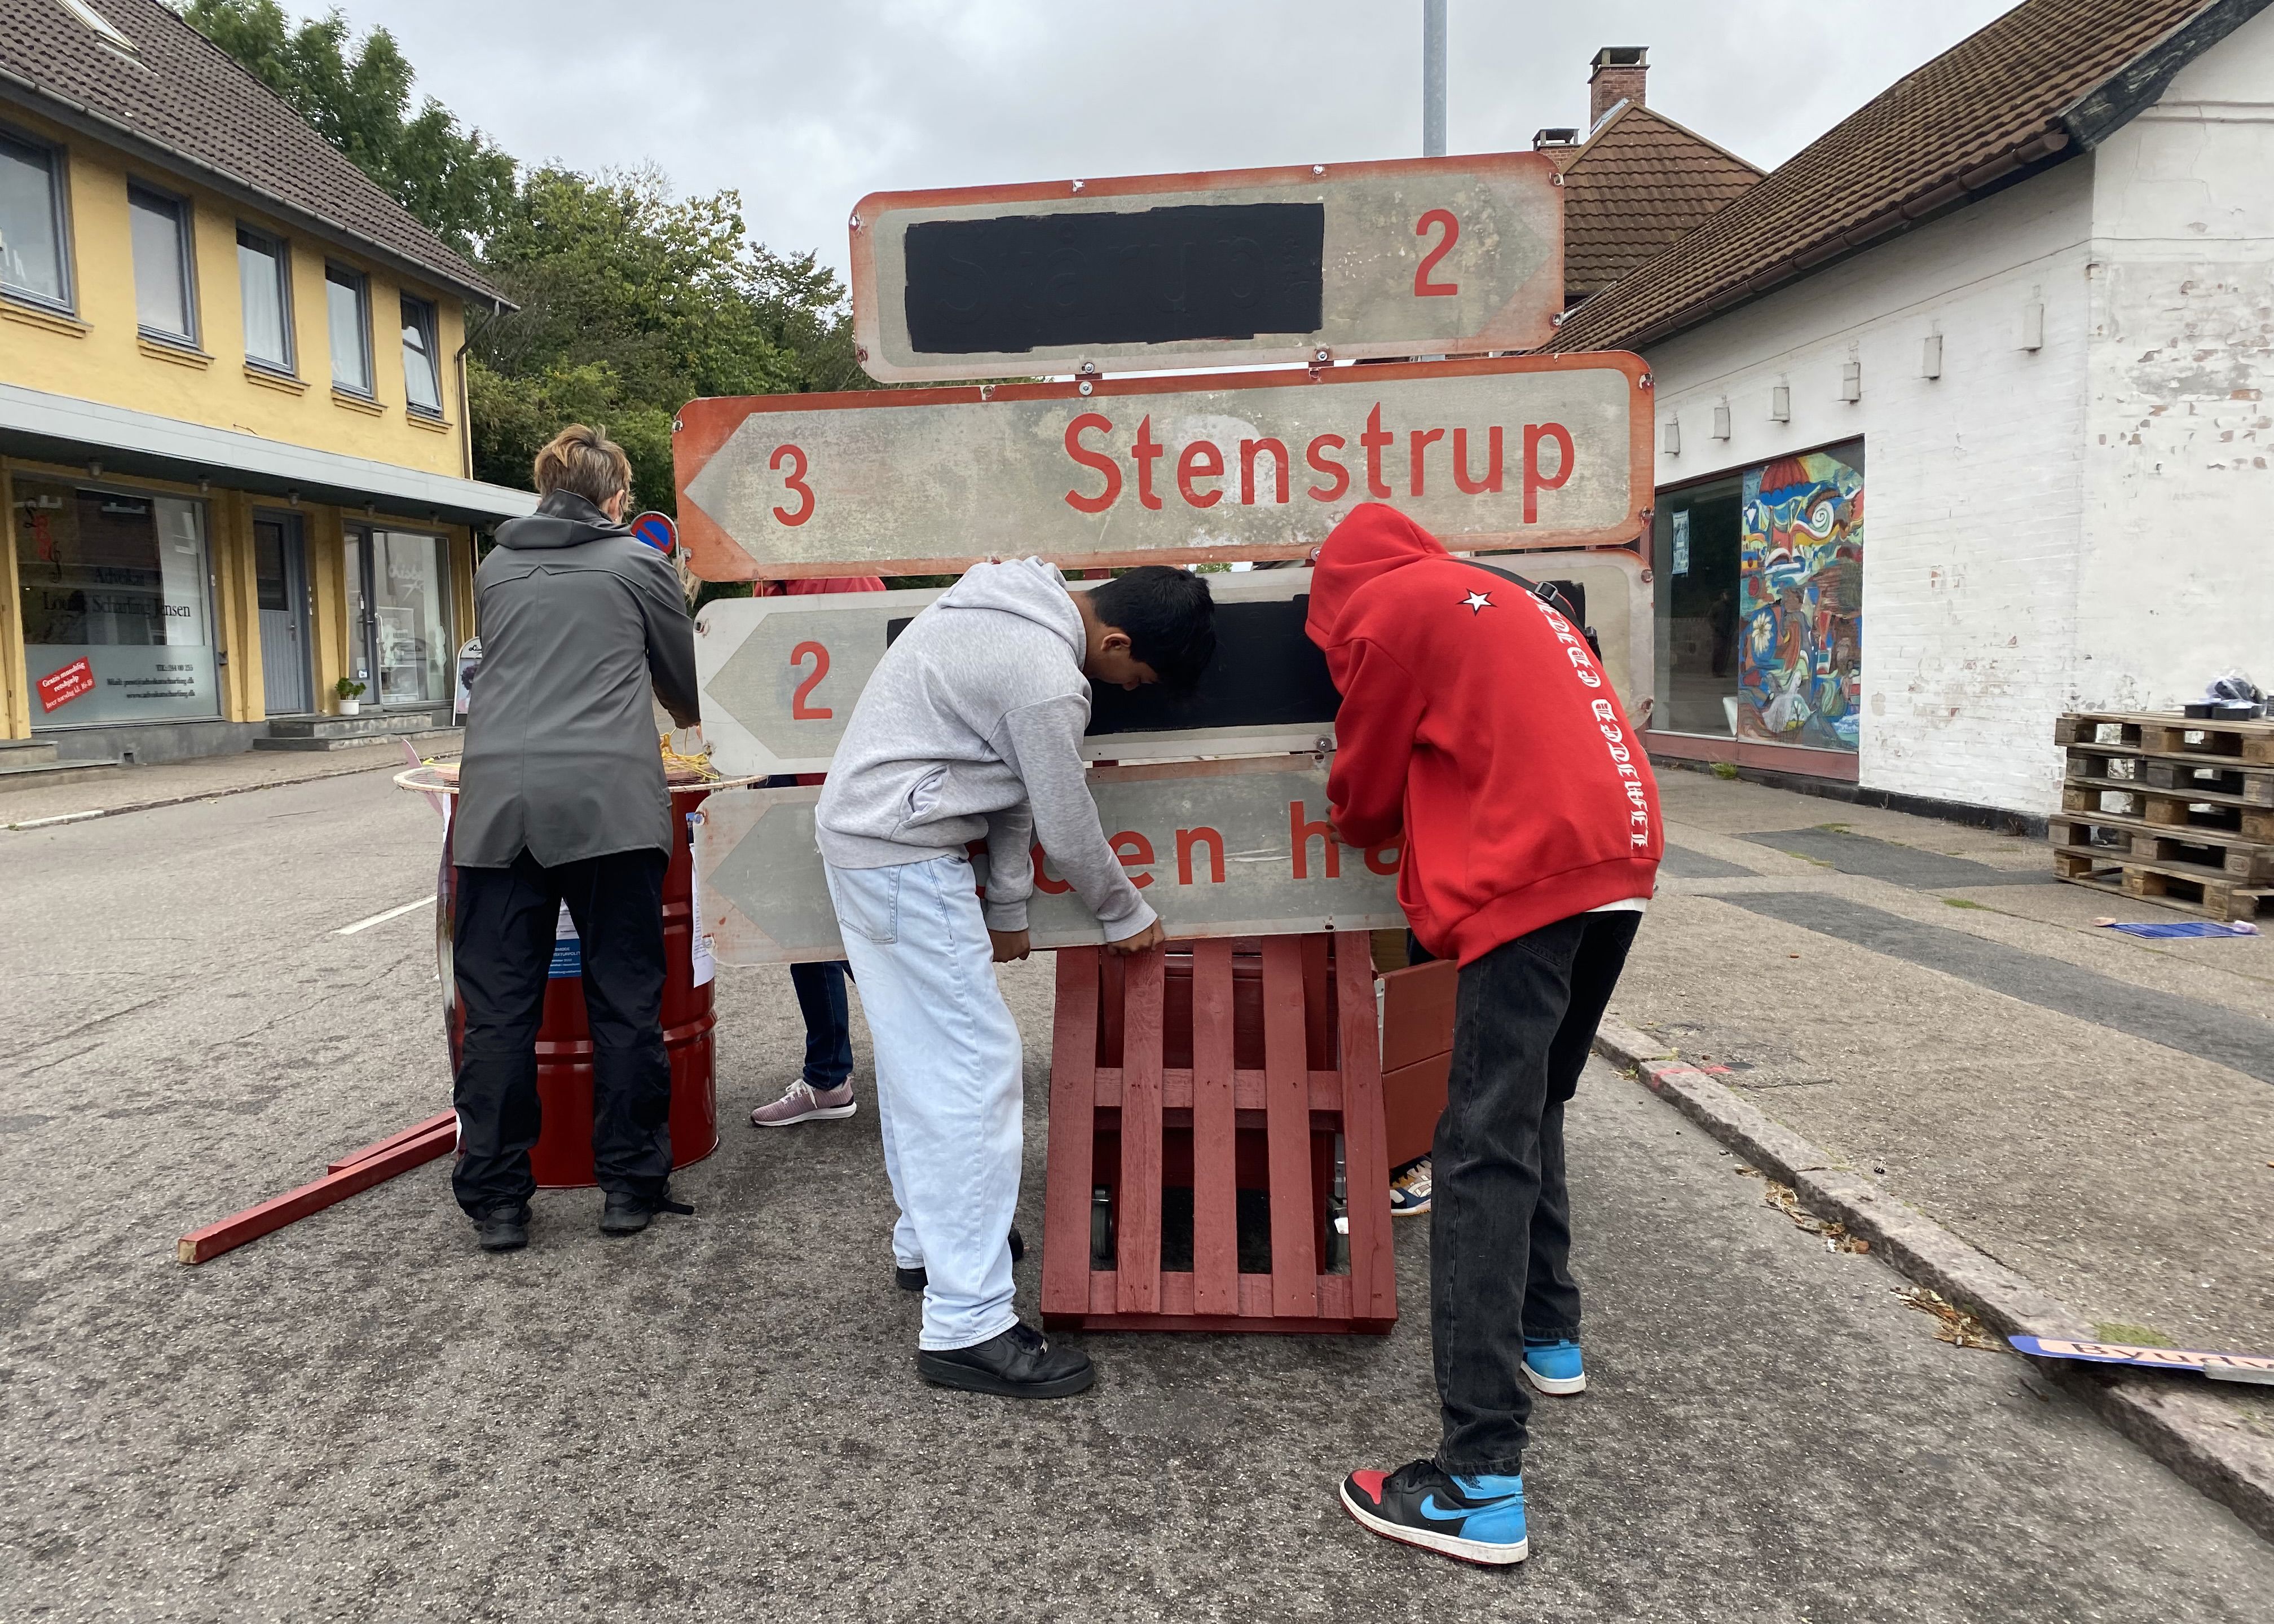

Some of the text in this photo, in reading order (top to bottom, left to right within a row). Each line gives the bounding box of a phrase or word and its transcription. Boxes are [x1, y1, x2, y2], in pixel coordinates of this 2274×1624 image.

[1414, 209, 1460, 297] 2
[769, 401, 1575, 527] 3 Stenstrup
[791, 641, 832, 720] 2
[1591, 699, 1649, 850] LIMITED
